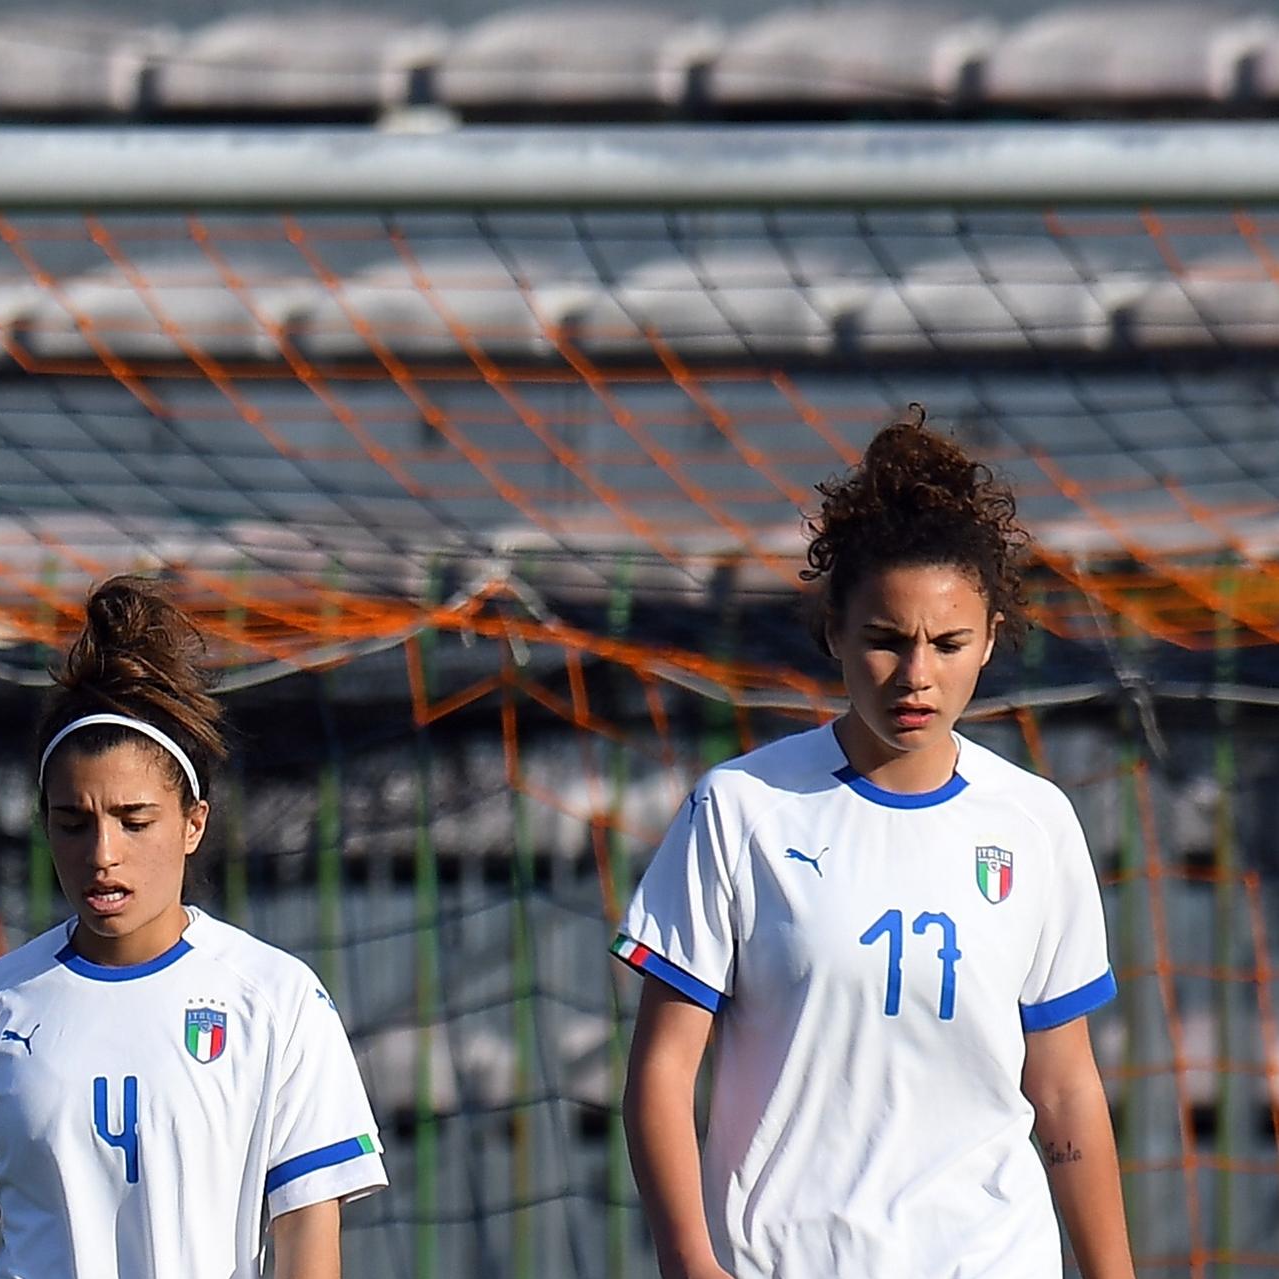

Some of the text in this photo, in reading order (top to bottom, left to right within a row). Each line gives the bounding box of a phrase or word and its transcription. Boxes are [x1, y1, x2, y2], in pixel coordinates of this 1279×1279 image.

[976, 847, 1011, 862] ITALIA
[859, 909, 963, 1020] 17
[187, 1010, 224, 1026] ITALIA
[93, 1076, 140, 1184] 4
